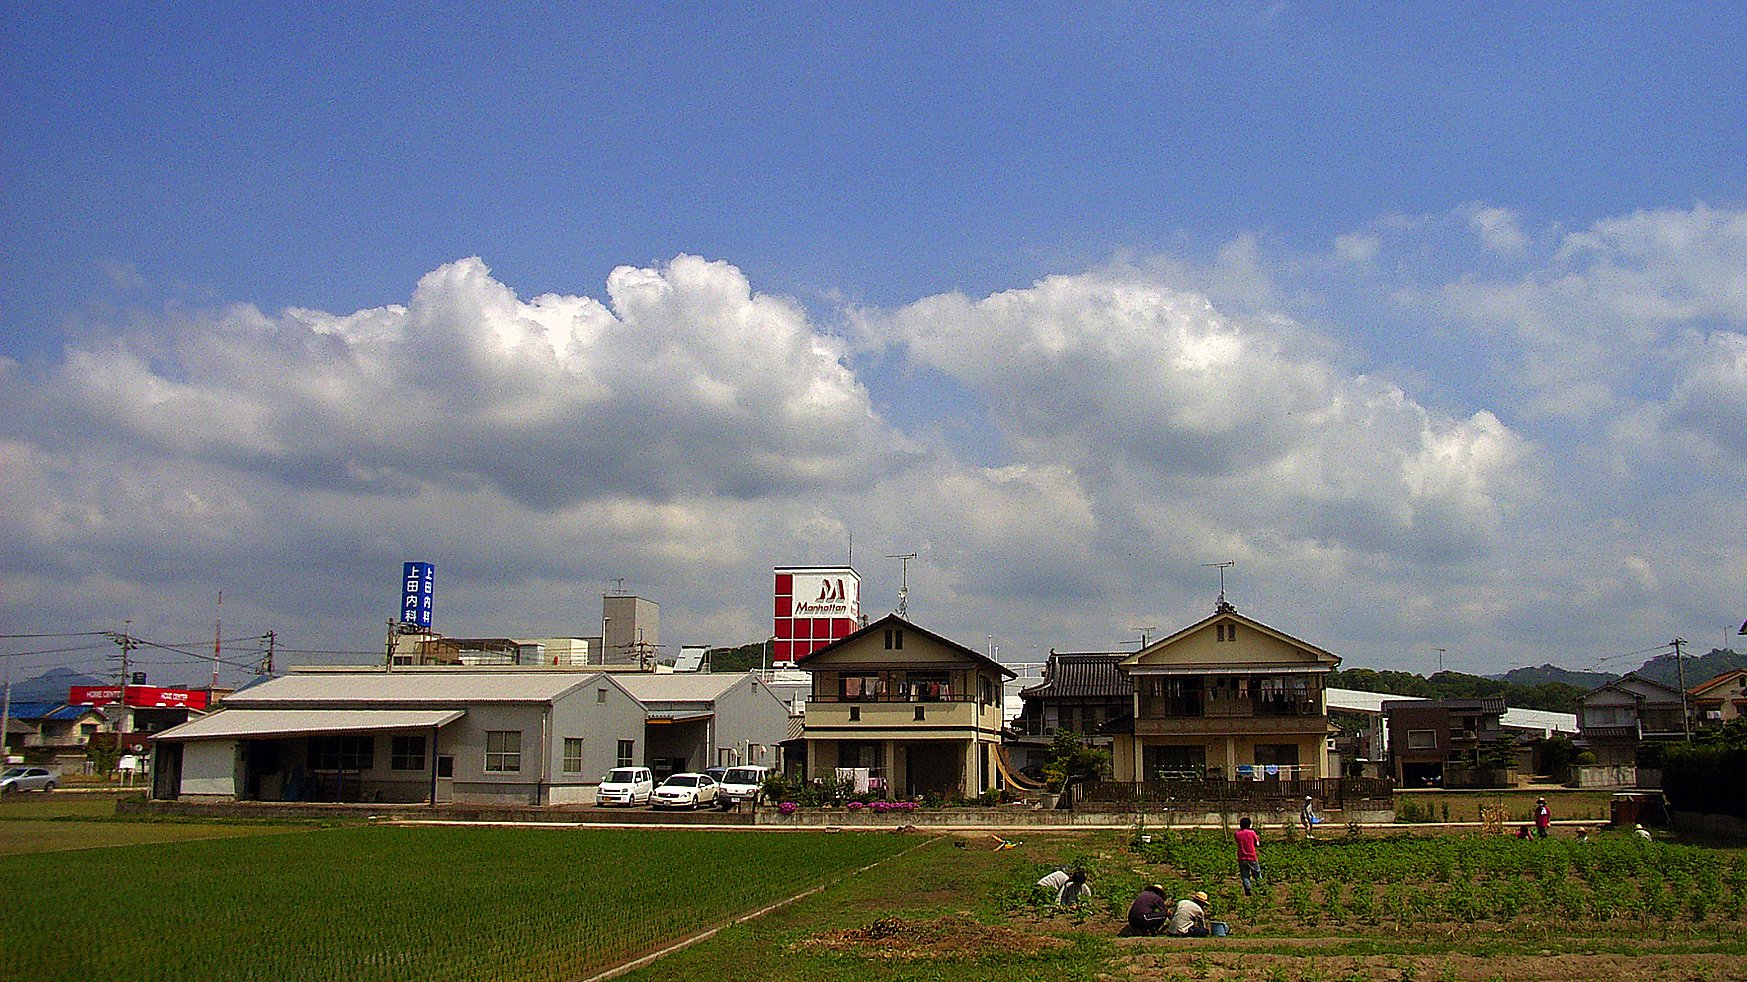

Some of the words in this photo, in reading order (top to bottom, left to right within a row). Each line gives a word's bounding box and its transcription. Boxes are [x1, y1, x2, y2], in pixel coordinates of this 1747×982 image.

[405, 565, 420, 622] 上田内科
[423, 567, 432, 623] 上田内科
[795, 601, 846, 614] Manhattan
